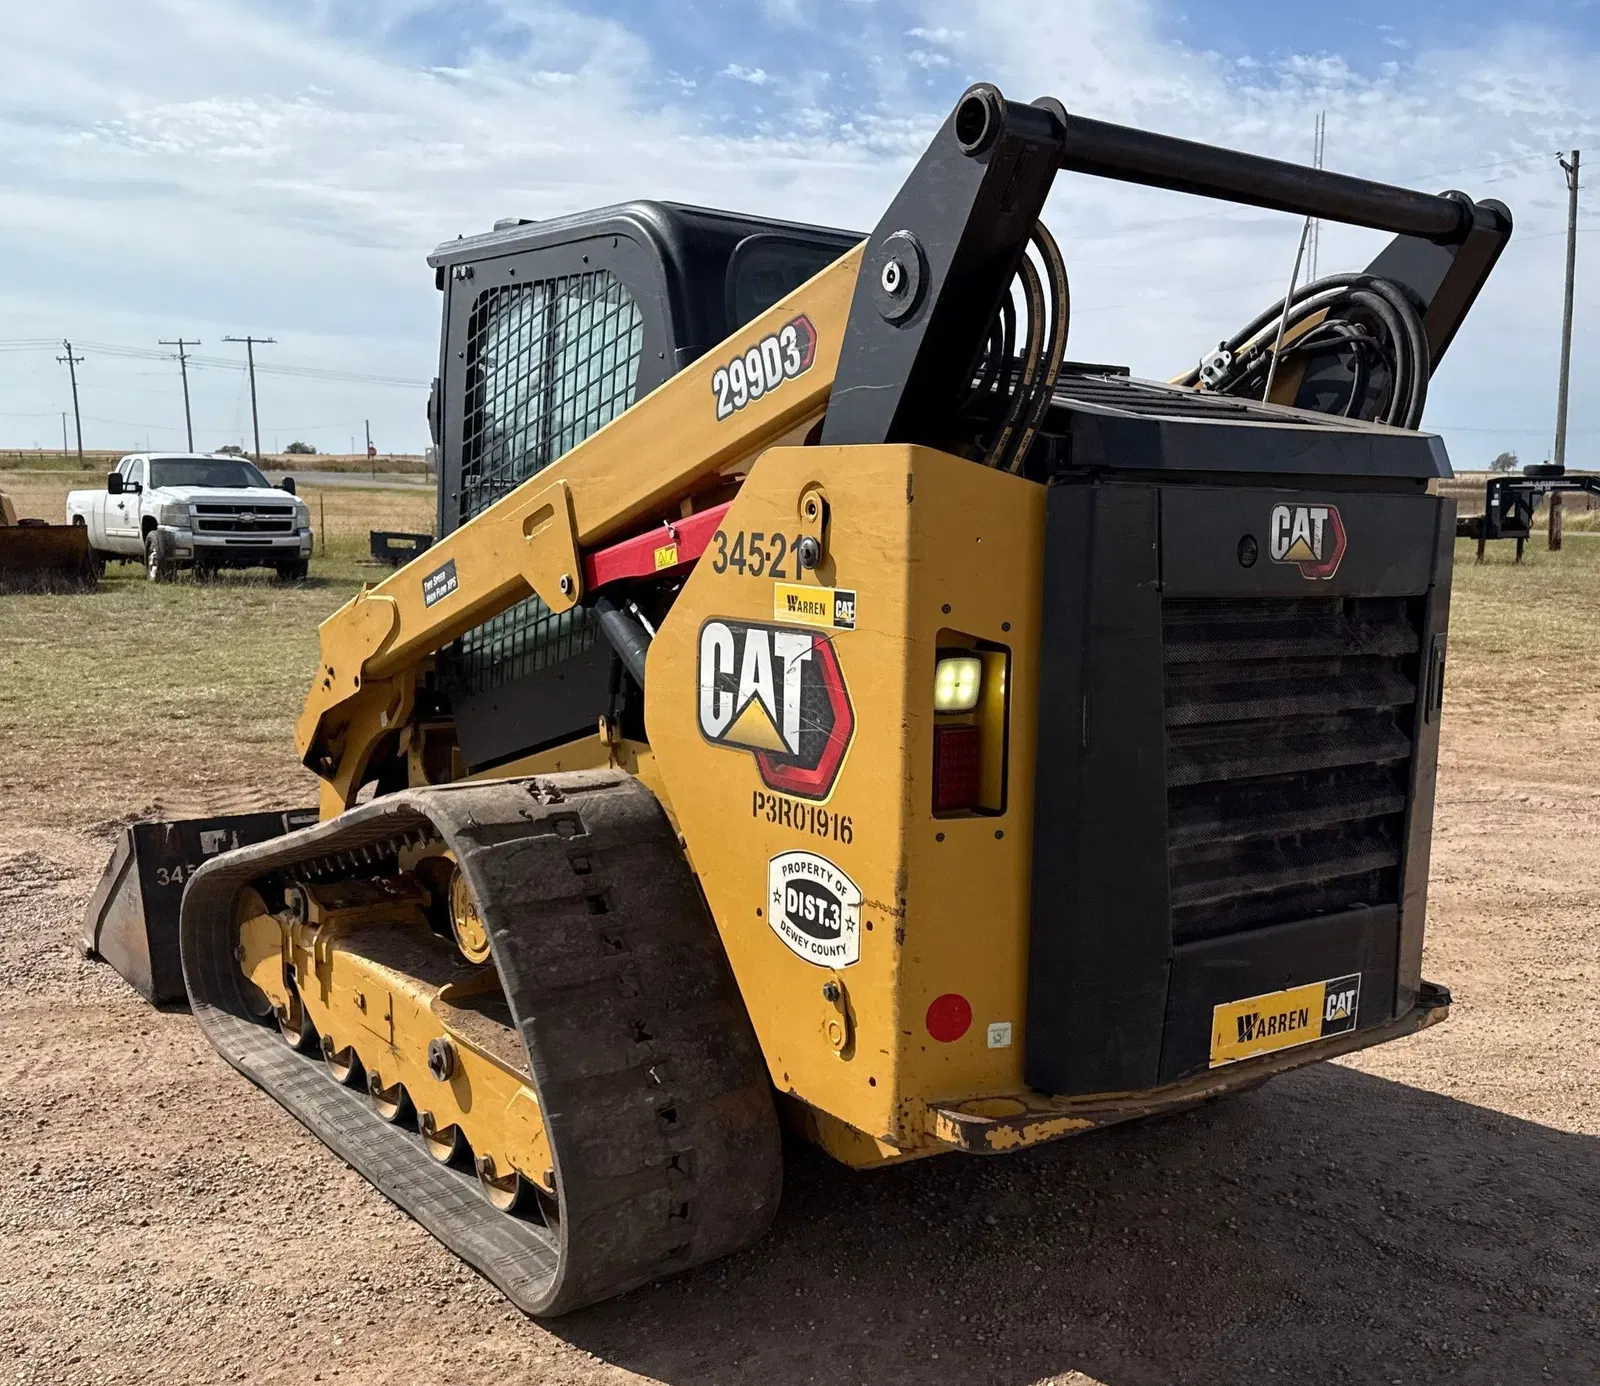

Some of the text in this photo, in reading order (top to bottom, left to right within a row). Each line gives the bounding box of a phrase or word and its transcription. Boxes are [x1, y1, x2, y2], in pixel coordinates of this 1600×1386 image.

[713, 325, 801, 419] 299D3
[1270, 505, 1328, 560] CAT
[786, 594, 855, 619] WARREN CAT
[700, 622, 812, 756] CAT
[752, 790, 853, 844] P3R01916
[782, 861, 847, 896] PROPERTY OF
[780, 919, 847, 956] DEWEY COUNTY
[1237, 989, 1356, 1043] WARREN CAT
